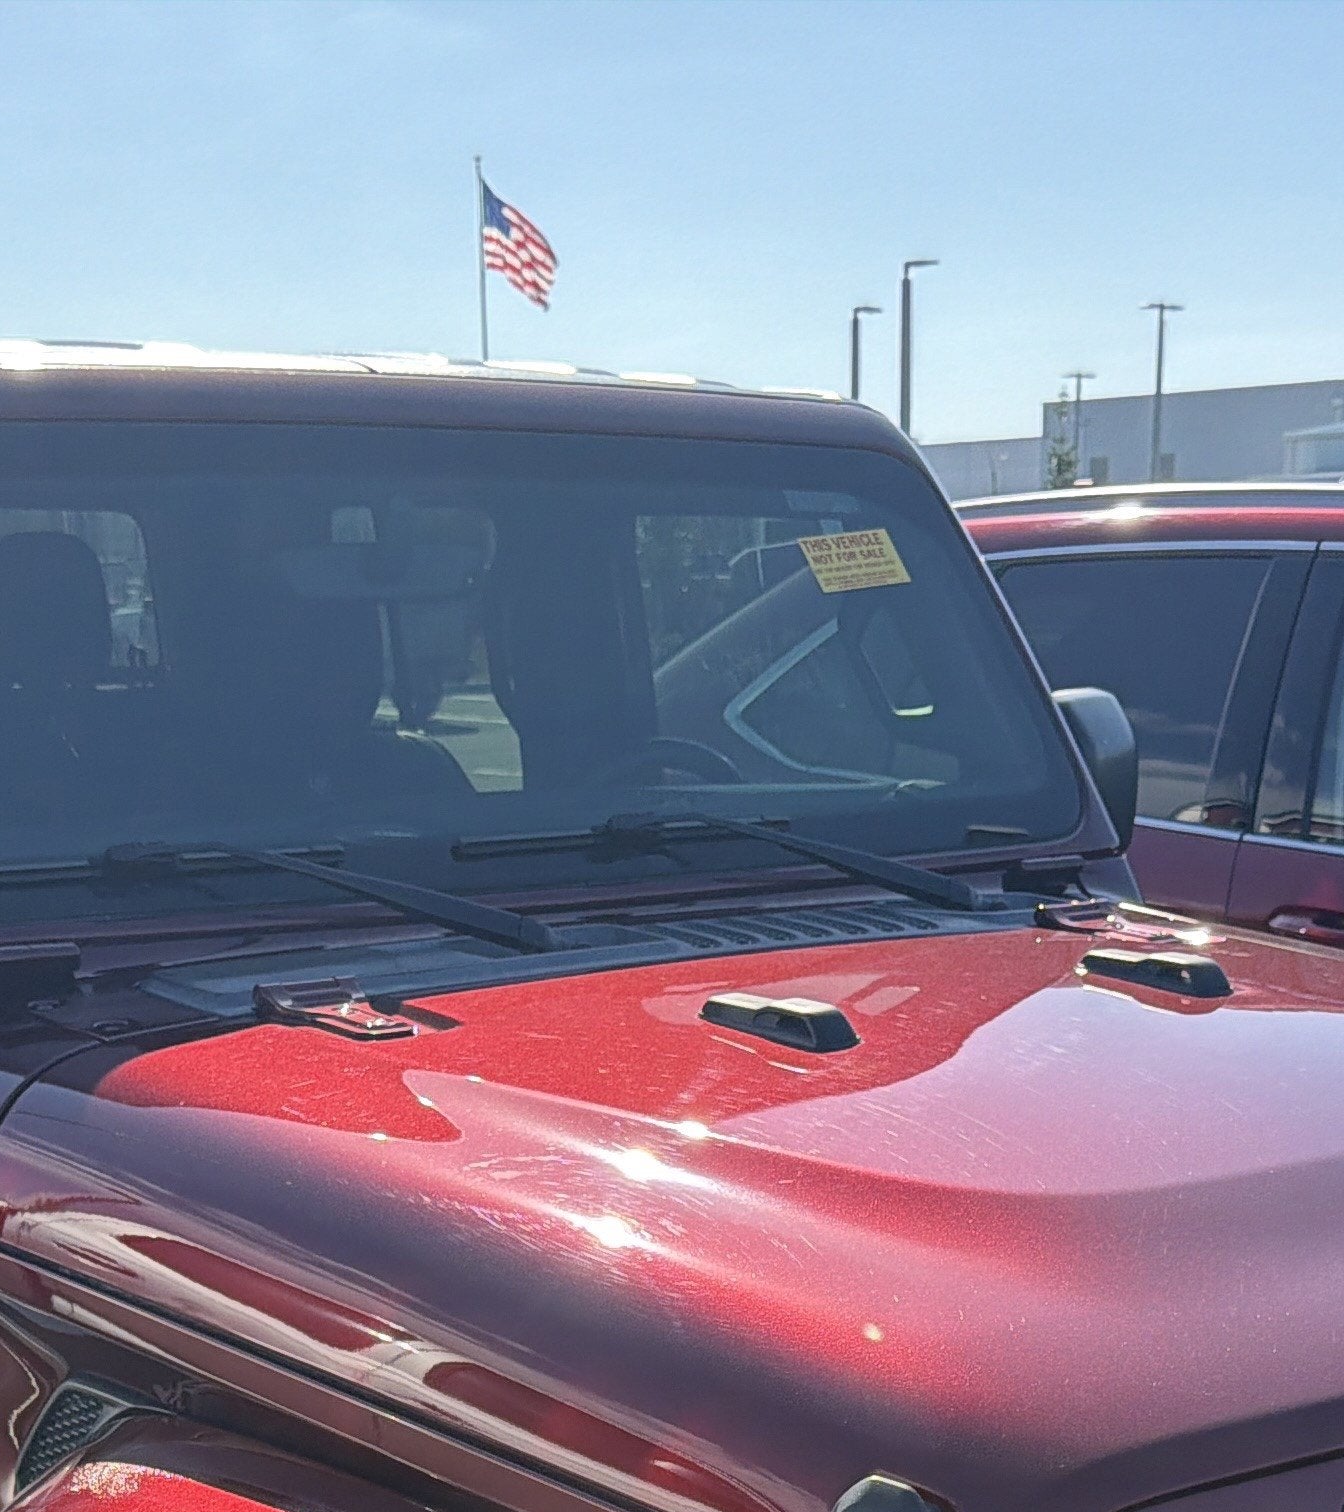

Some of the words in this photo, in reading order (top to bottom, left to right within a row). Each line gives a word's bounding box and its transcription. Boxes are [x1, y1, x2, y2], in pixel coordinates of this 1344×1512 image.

[800, 538, 832, 553] THIS
[831, 533, 884, 549] VEHICLE
[810, 553, 833, 565] NOT
[835, 551, 856, 562] FOR
[859, 548, 885, 560] SALE
